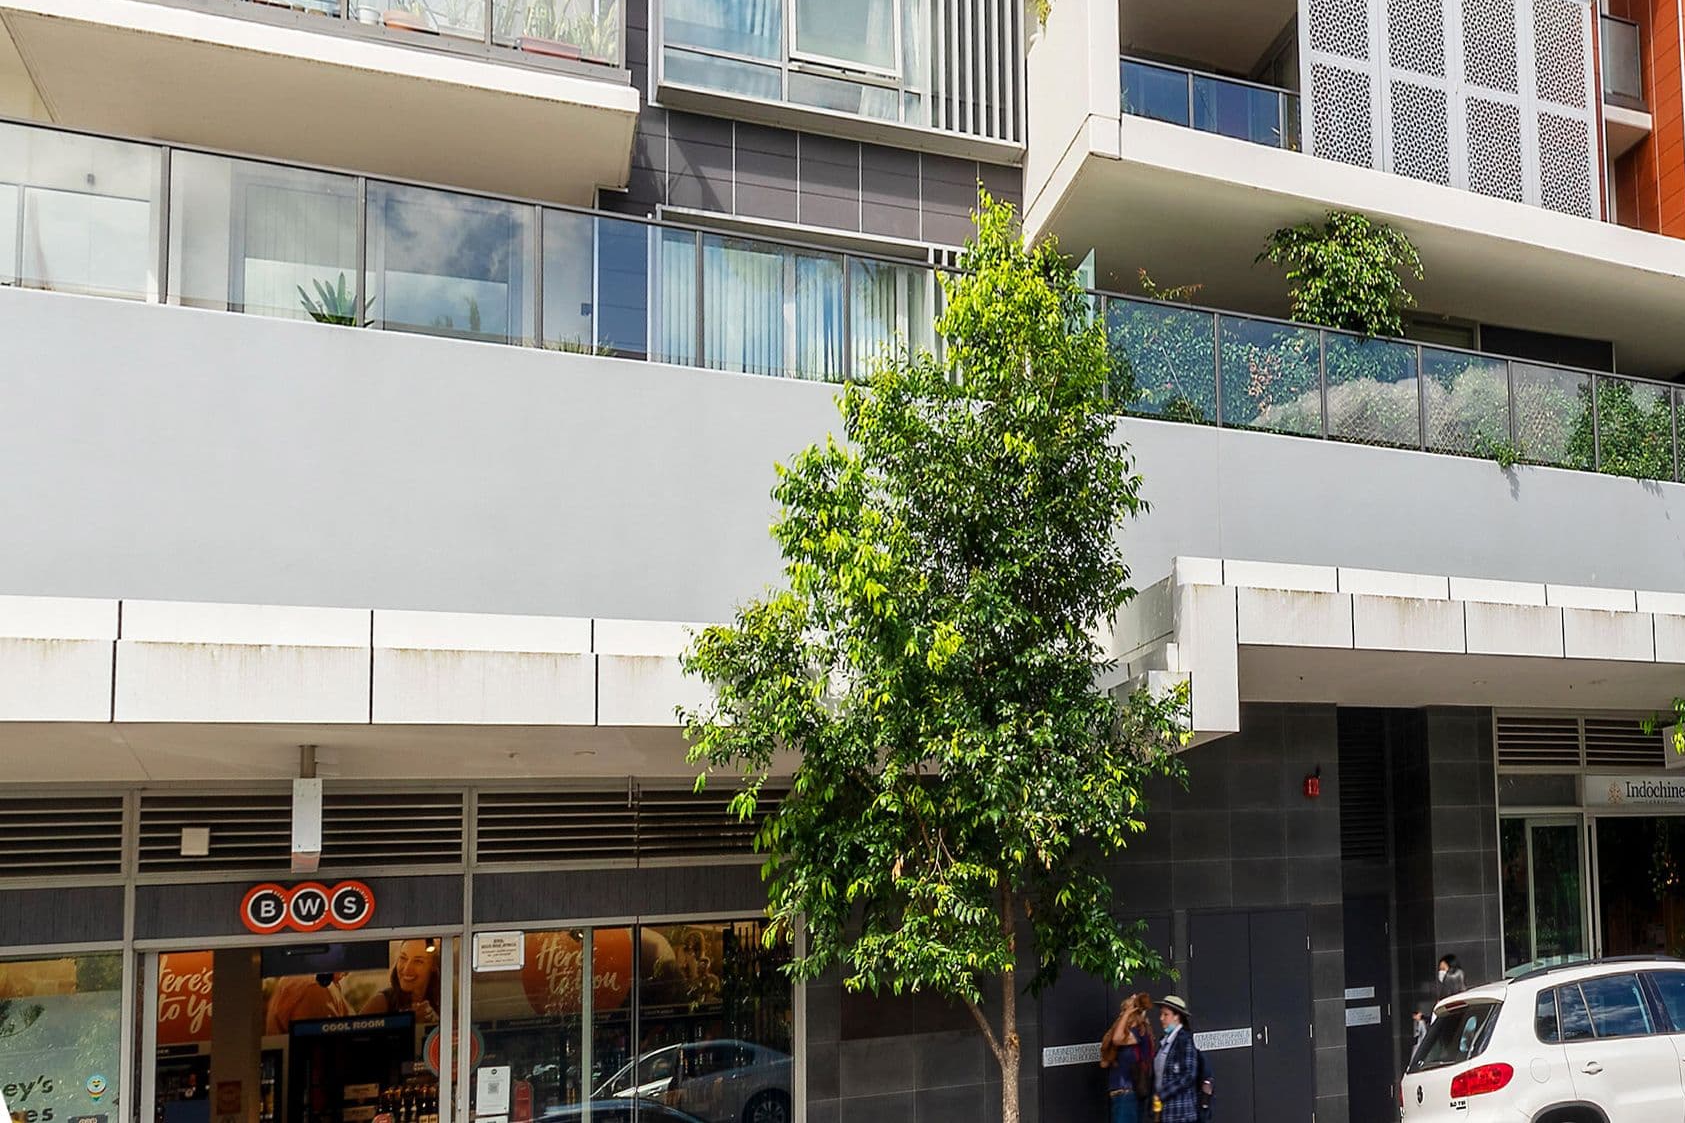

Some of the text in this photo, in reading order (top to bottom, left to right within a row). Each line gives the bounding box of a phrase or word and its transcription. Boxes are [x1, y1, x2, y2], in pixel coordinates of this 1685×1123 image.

[261, 896, 356, 918] BWS
[322, 1019, 385, 1032] COOL ROOM
[3, 1075, 53, 1101] ey's
